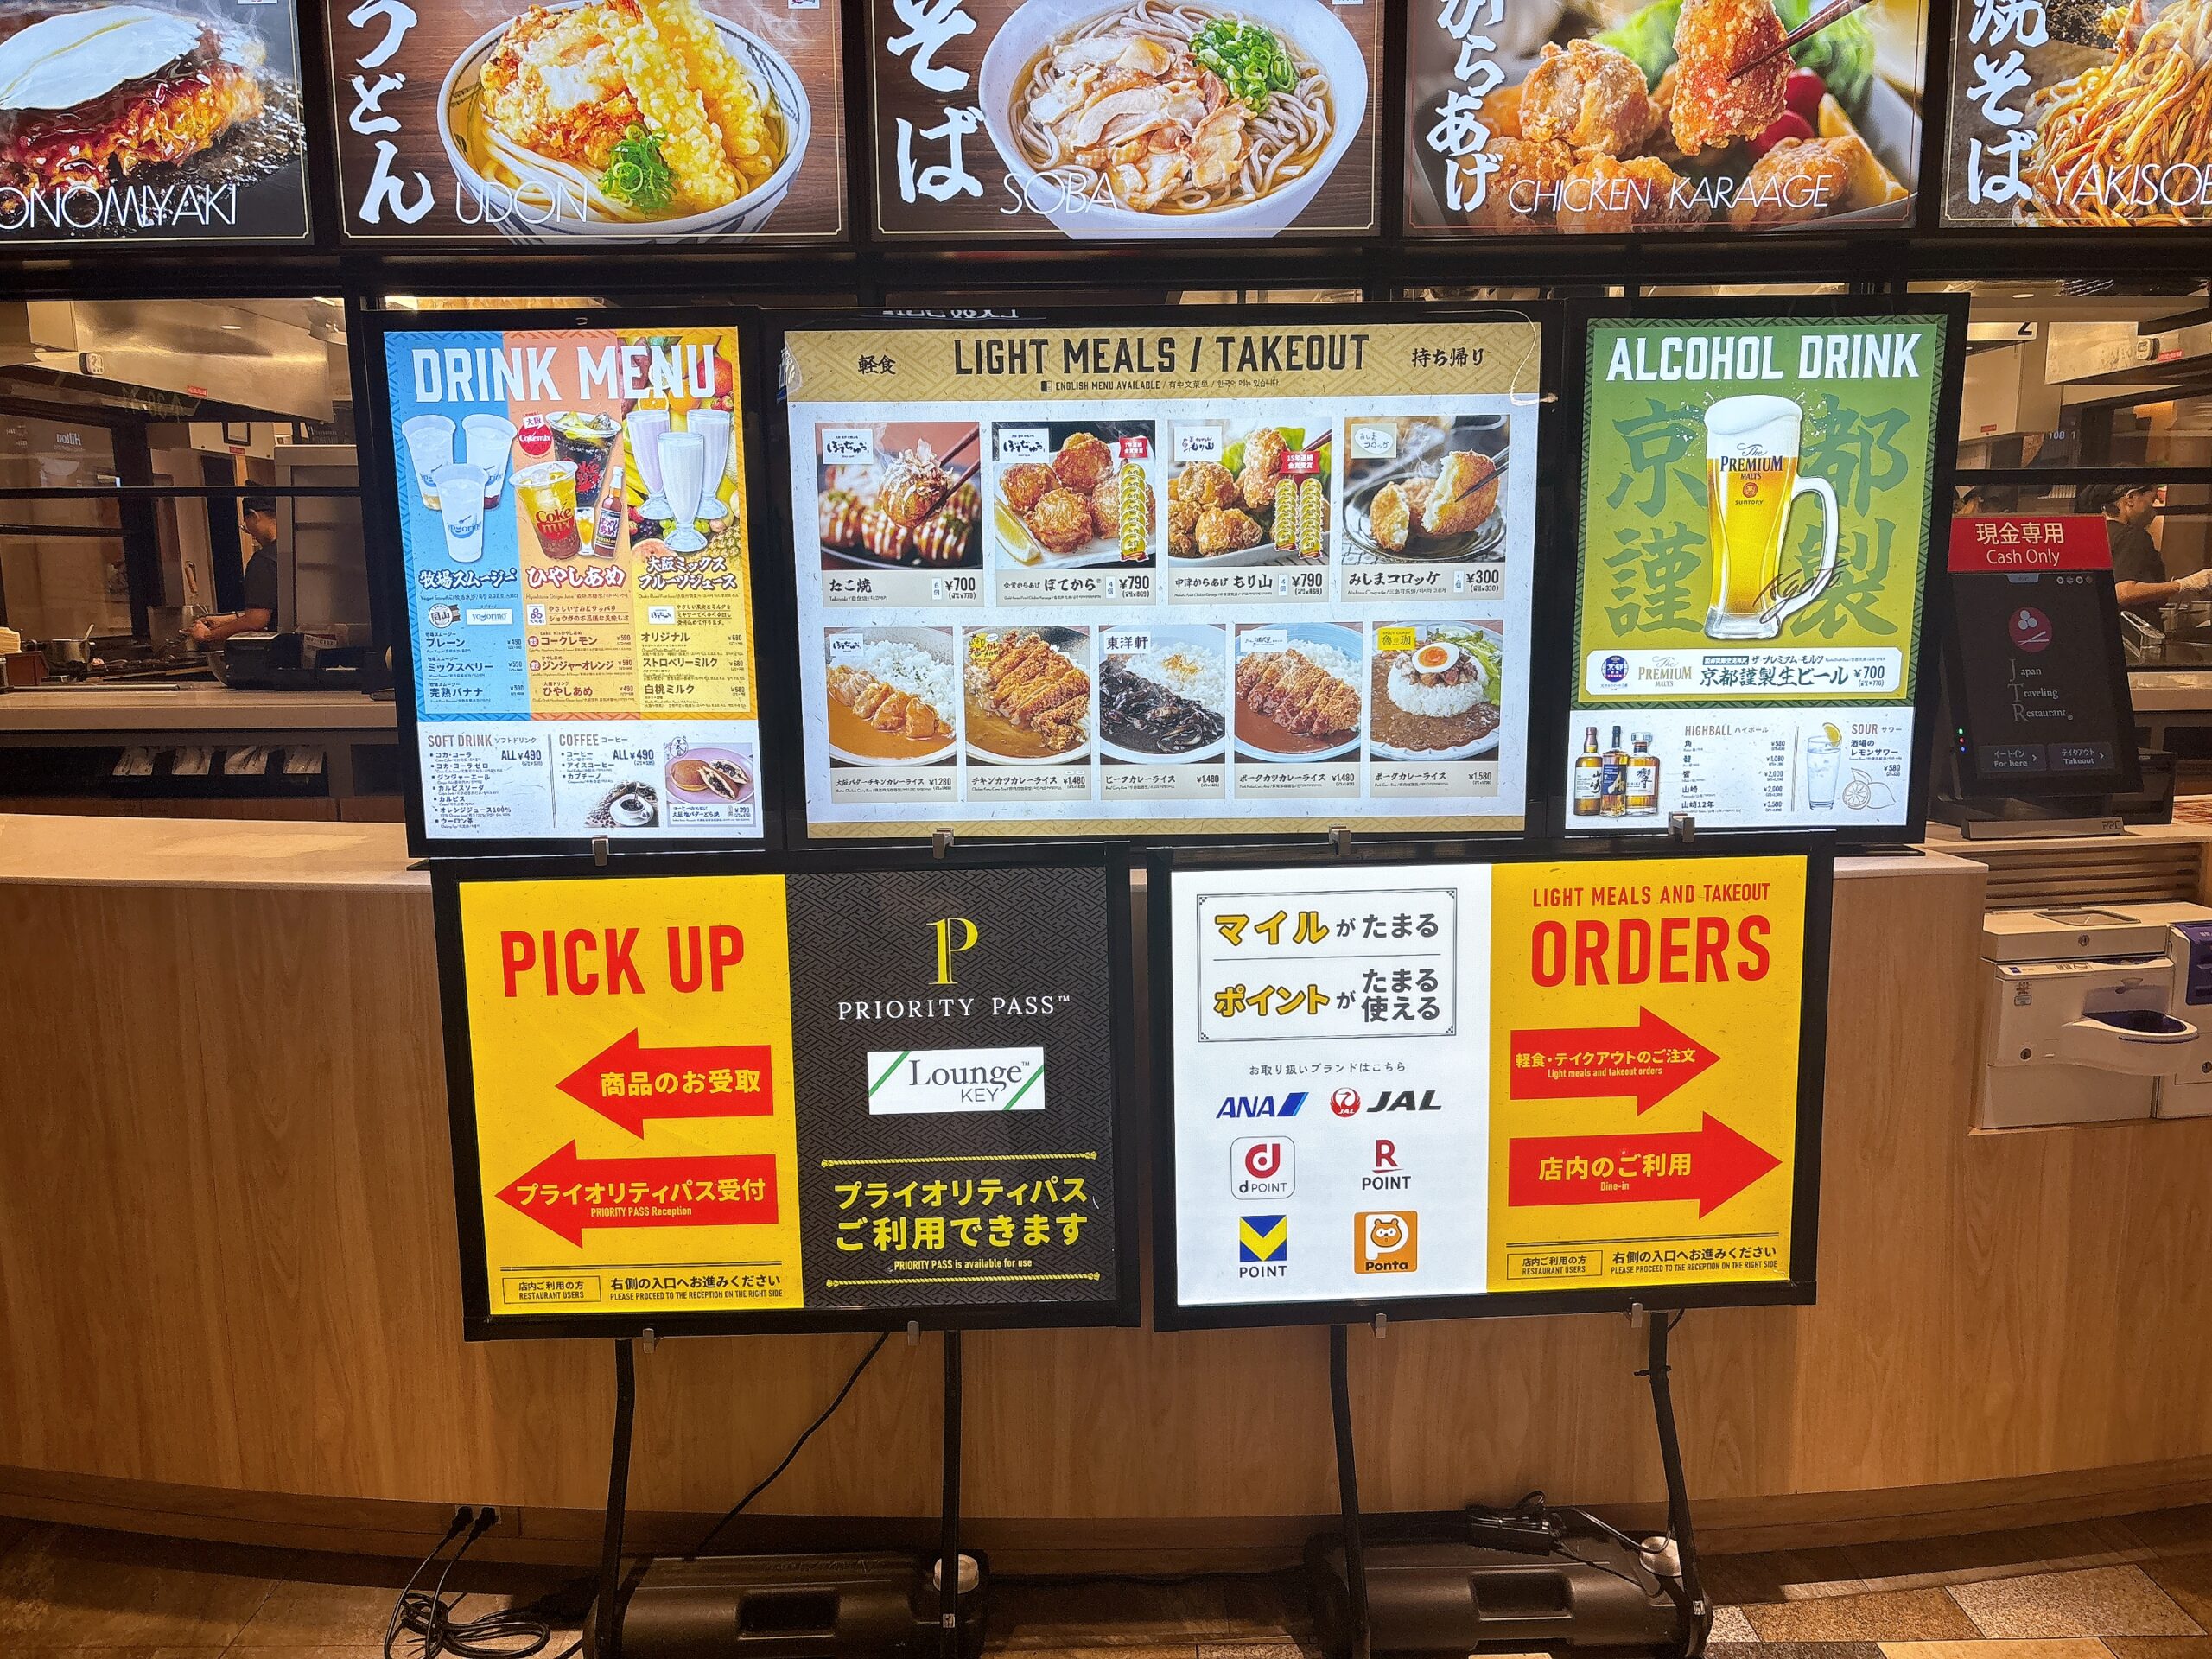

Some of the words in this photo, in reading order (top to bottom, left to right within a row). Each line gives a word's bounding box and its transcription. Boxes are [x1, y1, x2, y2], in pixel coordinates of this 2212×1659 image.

[887, 0, 988, 204] そば
[1000, 172, 1119, 216] SOBA
[1508, 178, 1652, 213] CHICKEN
[1669, 174, 1833, 209] KARAAGE
[455, 181, 589, 225] UDON
[954, 338, 1050, 375] LIGHT
[1063, 336, 1175, 374] MEALS
[1215, 334, 1370, 372] TAKEOUT
[1411, 346, 1484, 369] 持ち帰り
[1605, 334, 1783, 382] ALCOHOL
[1797, 334, 1923, 379] DRINK
[857, 354, 897, 376] 軽食
[411, 346, 561, 403] DRINK
[578, 345, 716, 401] MENU
[1056, 381, 1089, 391] ENGLISH
[1091, 380, 1114, 391] MENU
[1116, 380, 1160, 391] AVAILABLE
[1720, 454, 1783, 472] PREMIUM
[535, 506, 572, 523] Coke
[1975, 521, 2065, 546] 現金専用
[646, 555, 728, 573] 大阪ミックス
[1986, 549, 2023, 565] Cash
[2026, 548, 2061, 568] Only
[525, 564, 626, 589] ひやしあめ
[638, 573, 738, 591] フルーツジュース
[1119, 575, 1150, 590] ¥790
[1292, 573, 1323, 588] ¥790
[1349, 570, 1441, 586] みしまコロッケ
[1466, 569, 1499, 584] ¥300
[830, 578, 872, 594] たこ焼
[944, 577, 976, 592] ¥700
[426, 638, 465, 648] プレーン
[541, 636, 598, 646] コークレモン
[641, 632, 690, 642] オリジナル
[1106, 636, 1149, 650] 東洋軒
[428, 662, 493, 672] ミックスベリー
[542, 660, 614, 671] ジンジャーオレンジ
[643, 657, 718, 667] ストロベリーミルク
[1637, 666, 1693, 681] PREMIUM
[1700, 665, 1849, 688] 京都謹製生ビール
[1853, 665, 1885, 679] ¥700
[2009, 658, 2043, 683] Japan
[429, 687, 483, 698] 完熟バナナ
[543, 686, 594, 696] ひやしあめ
[645, 683, 695, 695] 白桃ミルク
[2006, 683, 2059, 702] Traveling
[1685, 725, 1732, 737] HIGHBALL
[1851, 723, 1878, 734] SOUR
[428, 734, 454, 747] SOFT
[457, 734, 493, 747] DRINK
[559, 734, 600, 747] COFFEE
[1993, 749, 2025, 759] イートイン
[971, 776, 1058, 785] チキンカツカレーライス
[1105, 774, 1176, 785] ビーフカレーライス
[1239, 773, 1326, 783] ポークカツカレーライス
[1374, 772, 1447, 781] ポークカレーライス
[1533, 887, 1584, 907] LIGHT
[1591, 886, 1652, 906] MEALS
[1660, 884, 1696, 904] AND
[1703, 882, 1770, 902] TAKEOUT
[1531, 914, 1771, 988] ORDERS
[499, 927, 646, 998] PICK
[666, 925, 745, 995] UP
[837, 998, 976, 1020] PRIORITY
[1362, 995, 1441, 1023] 使える
[1515, 1048, 1696, 1068] 軽食・テイクアウトのご注文
[1249, 1061, 1407, 1076] お取り扱いブランドはこちら
[1548, 1068, 1567, 1078] Light
[1568, 1068, 1591, 1077] meals
[1592, 1067, 1607, 1077] and
[1608, 1066, 1637, 1077] takeout
[1638, 1066, 1662, 1076] orders
[600, 1068, 762, 1098] 商品のお受取
[961, 1086, 1000, 1103] KEY
[1216, 1095, 1275, 1118] ANA
[1367, 1090, 1442, 1113] JAL
[1538, 1152, 1692, 1181] 店内のご利用
[1250, 1182, 1287, 1193] POINT
[1362, 1176, 1411, 1191] POINT
[1600, 1180, 1630, 1192] Dine-in
[516, 1178, 766, 1206] プライオリティパス受付
[834, 1175, 1089, 1211] プライオリティパス
[590, 1207, 626, 1217] PRIORITY
[628, 1206, 650, 1217] PASS
[652, 1205, 692, 1217] Reception
[836, 1212, 1089, 1252] ご利用できます
[1522, 1255, 1587, 1267] 店内ご利用の方
[1612, 1247, 1777, 1264] 右側の入口へお進みください
[893, 1260, 929, 1271] PRIORITY
[931, 1260, 953, 1270] PASS
[955, 1260, 963, 1269] is
[964, 1259, 1001, 1269] available
[1003, 1259, 1014, 1268] for
[1017, 1260, 1033, 1268] use
[1239, 1265, 1287, 1279] POINT
[1364, 1260, 1409, 1272] Ponta
[1522, 1266, 1564, 1275] RESTAURANT
[1565, 1265, 1586, 1274] USERS
[1611, 1266, 1634, 1274] PLEASE
[1636, 1265, 1663, 1274] PROCEED
[1665, 1264, 1673, 1273] TO
[1722, 1262, 1731, 1271] ON
[1745, 1262, 1761, 1270] RIGHT
[1763, 1261, 1777, 1269] SIDE
[518, 1281, 585, 1292] 店内ご利用の方
[610, 1275, 782, 1292] 右側の入口へお進みください
[518, 1291, 562, 1300] RESTAURANT
[563, 1291, 585, 1300] USERS
[610, 1292, 634, 1300] PLEASE
[636, 1292, 664, 1300] PROCEED
[666, 1291, 675, 1300] TO
[676, 1291, 688, 1300] THE
[689, 1290, 724, 1299] RECEPTION
[725, 1290, 734, 1299] ON
[735, 1289, 747, 1298] THE
[748, 1289, 766, 1298] RIGHT
[768, 1289, 783, 1298] SIDE
